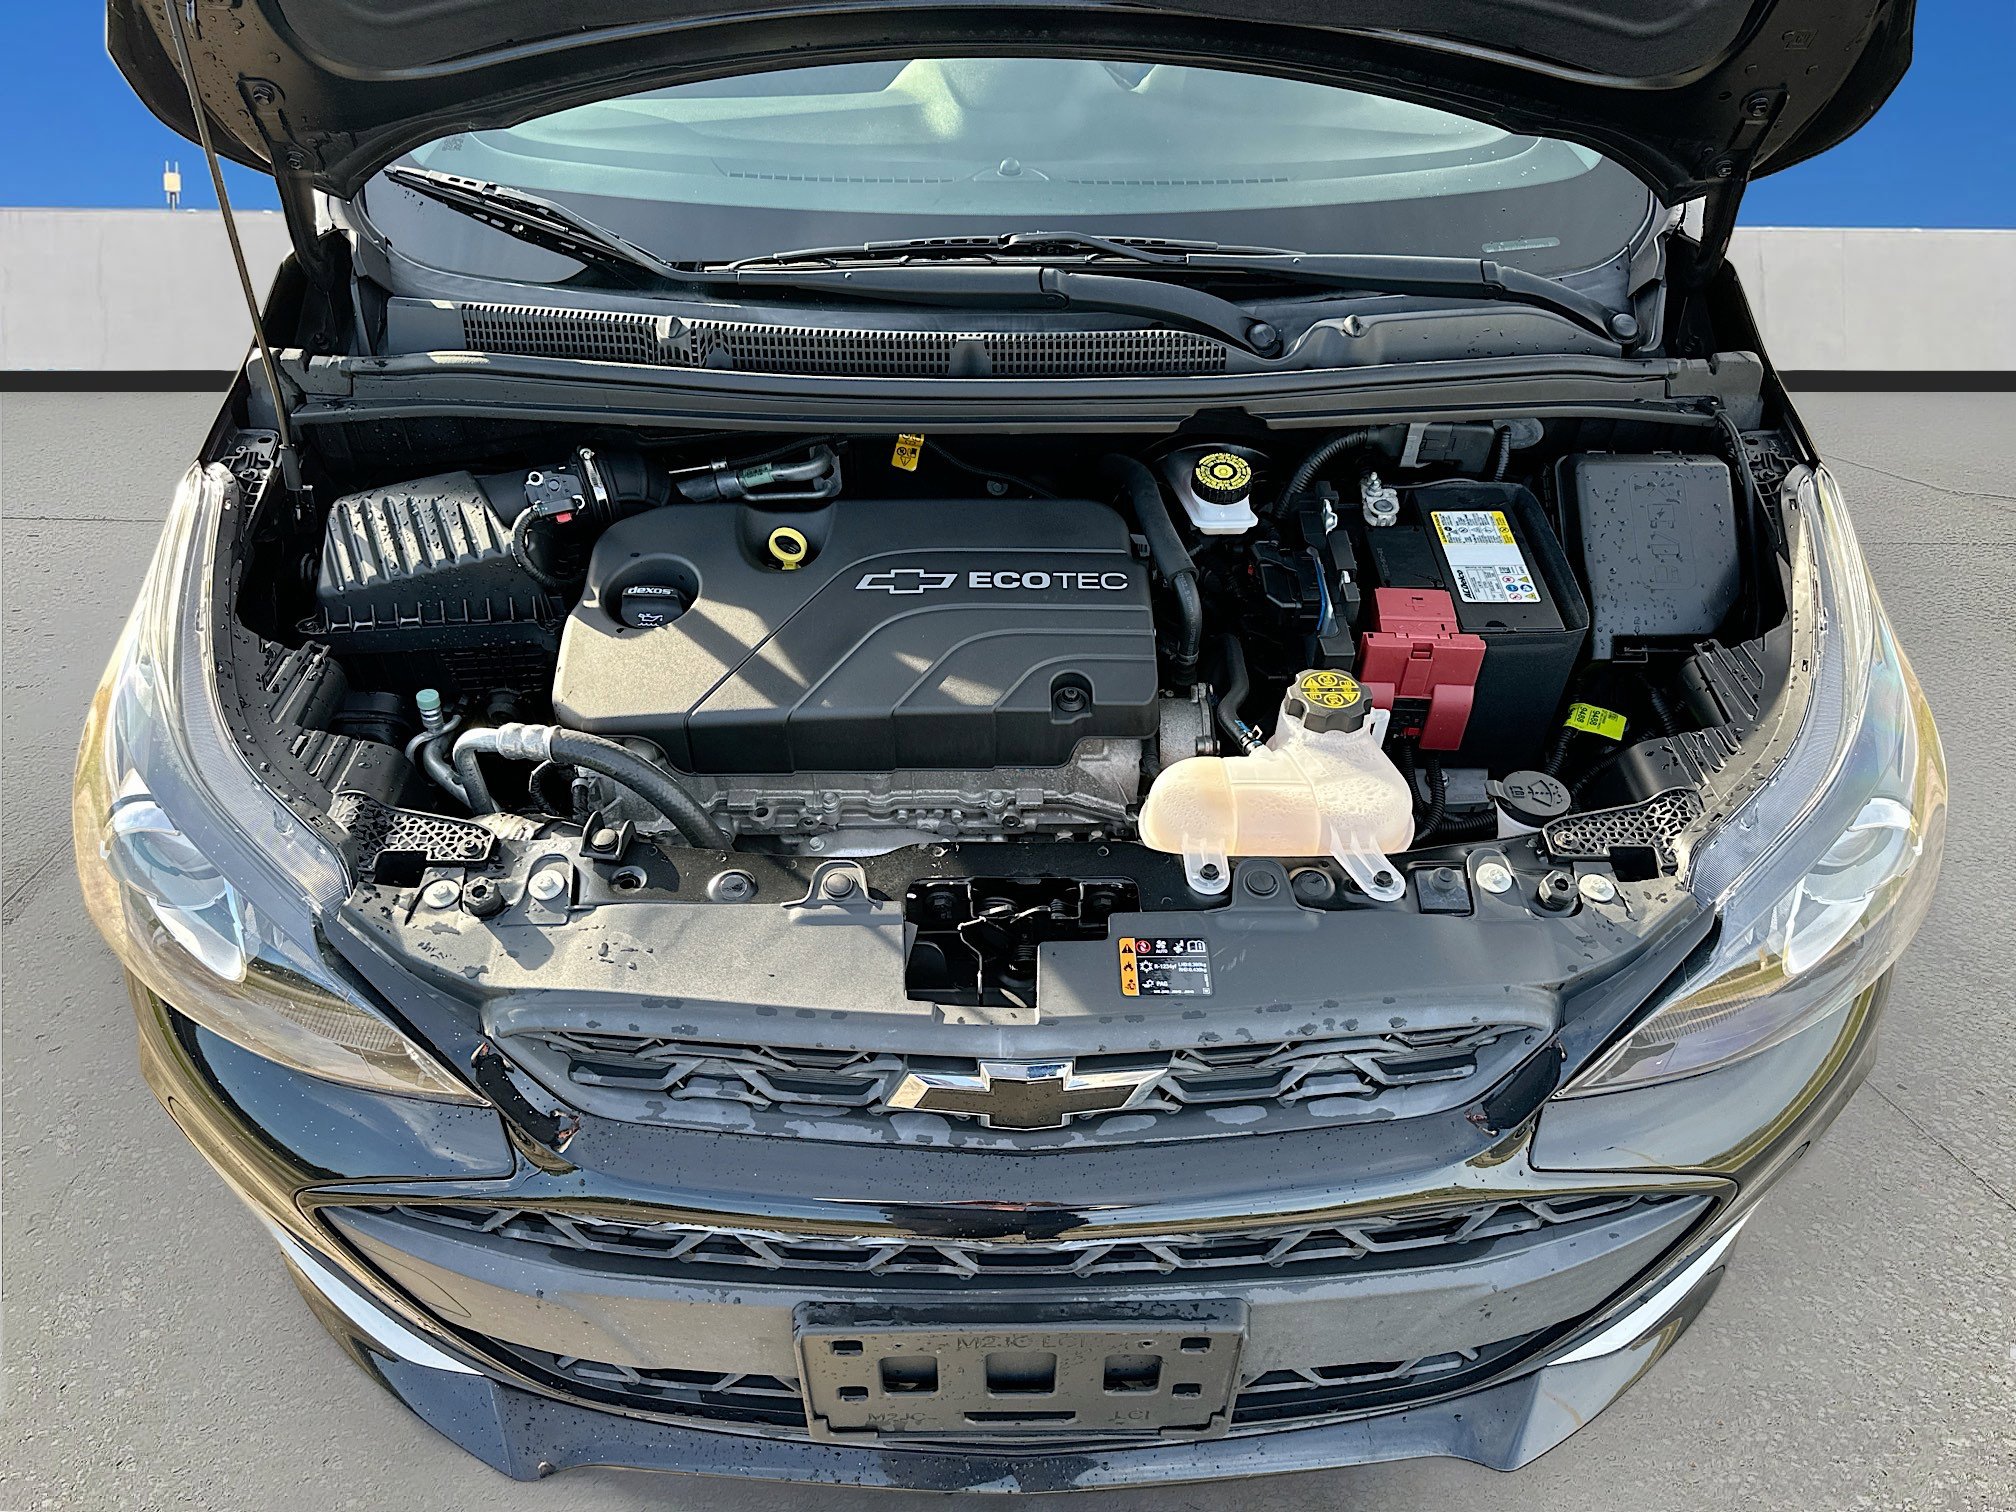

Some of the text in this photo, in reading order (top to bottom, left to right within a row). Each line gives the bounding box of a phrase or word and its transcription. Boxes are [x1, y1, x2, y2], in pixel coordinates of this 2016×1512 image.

[968, 571, 1129, 590] ECOTEC
[1456, 569, 1473, 599] ACDelco
[627, 586, 673, 595] dexos
